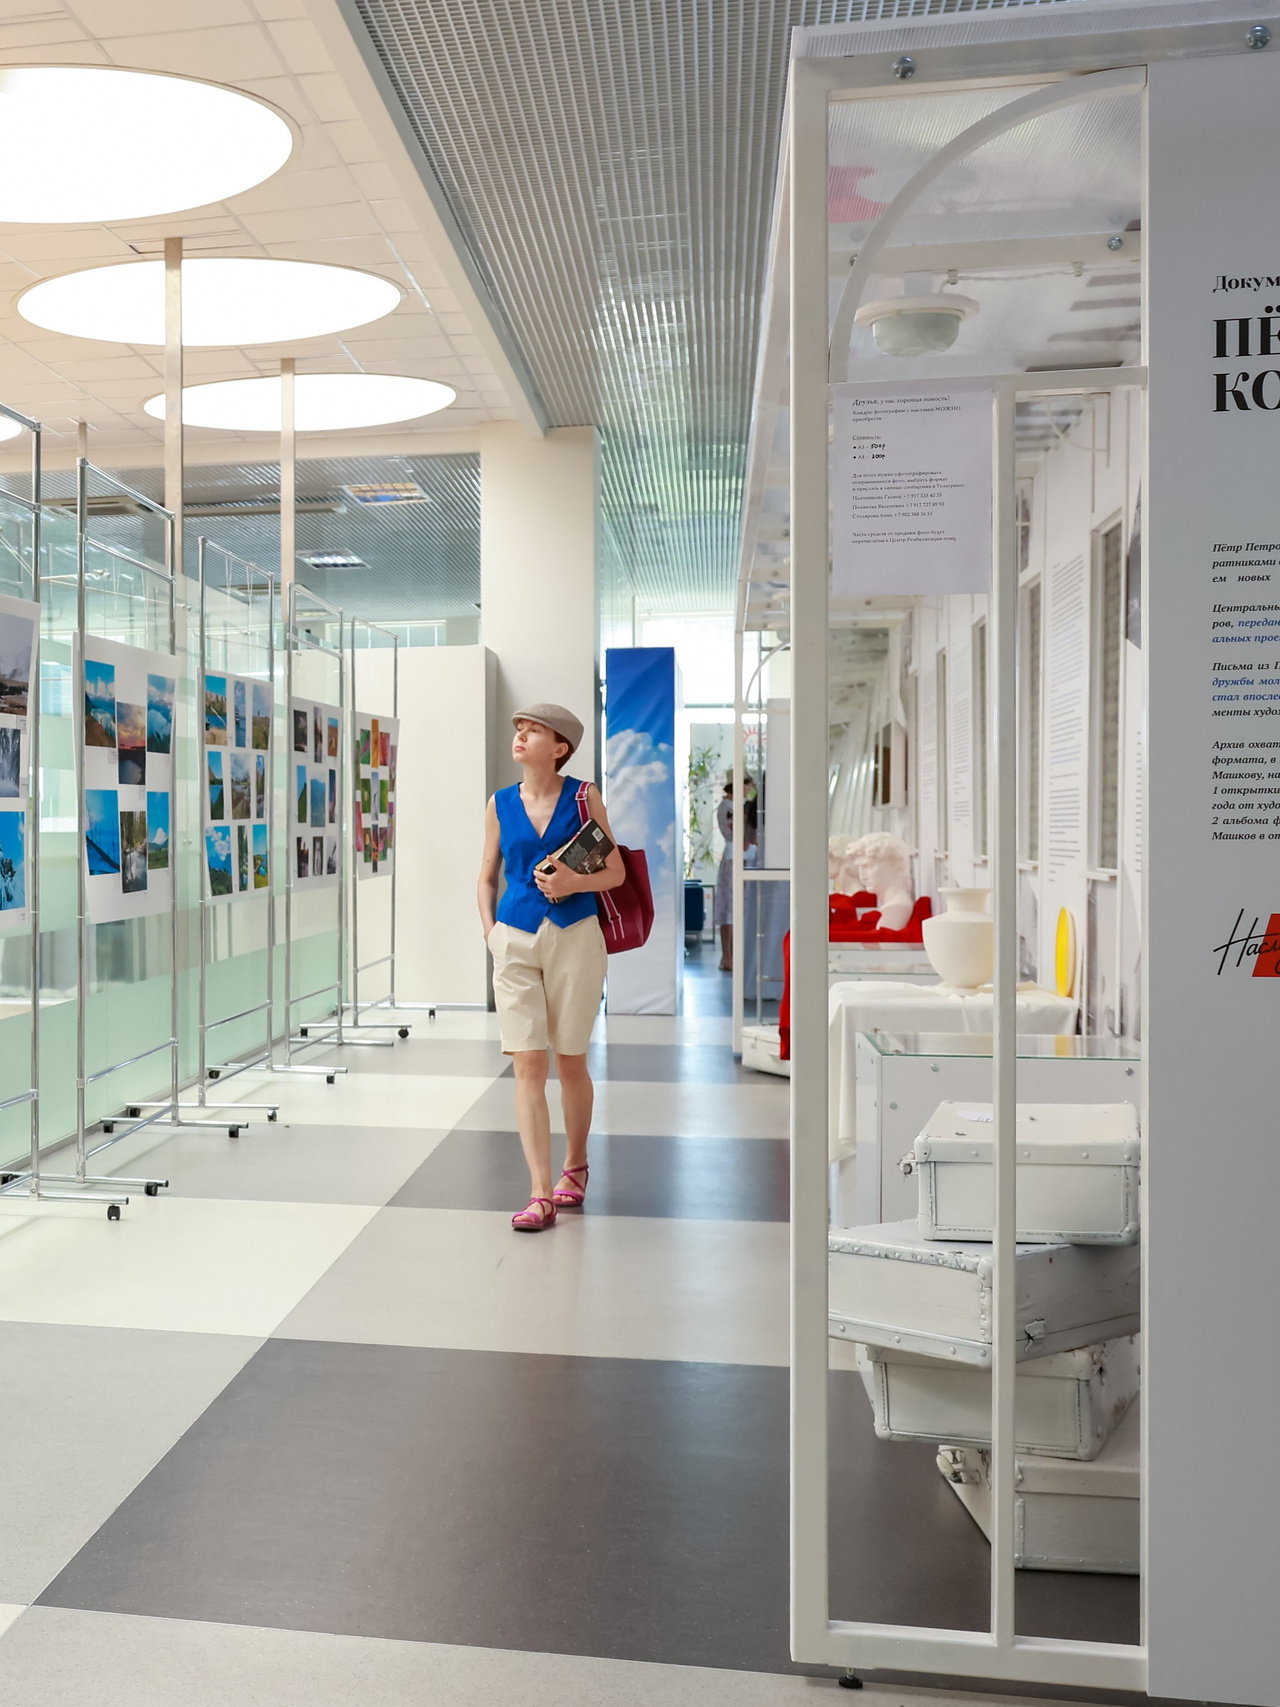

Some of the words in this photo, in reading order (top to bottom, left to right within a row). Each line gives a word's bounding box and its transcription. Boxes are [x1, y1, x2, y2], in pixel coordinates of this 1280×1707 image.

[1213, 275, 1280, 293] Докум
[1213, 305, 1280, 358] ПЁ
[1213, 370, 1280, 412] КО
[1212, 543, 1242, 553] Пётр
[1212, 559, 1276, 569] ратниками
[1238, 574, 1271, 582] новых
[1212, 620, 1233, 629] ров,
[1254, 634, 1280, 643] прое
[1212, 662, 1253, 670] Письма
[1212, 677, 1255, 688] дружбы
[1243, 693, 1280, 701] впосле
[1211, 709, 1251, 717] менты
[1253, 706, 1280, 718] худо
[1212, 741, 1245, 751] Архив
[1212, 755, 1267, 766] формата,
[1212, 771, 1265, 781] Машкову,
[1213, 786, 1218, 795] 1
[1212, 801, 1235, 810] года
[1212, 816, 1219, 825] 2
[1223, 816, 1269, 825] альбома
[1212, 831, 1256, 840] Машков
